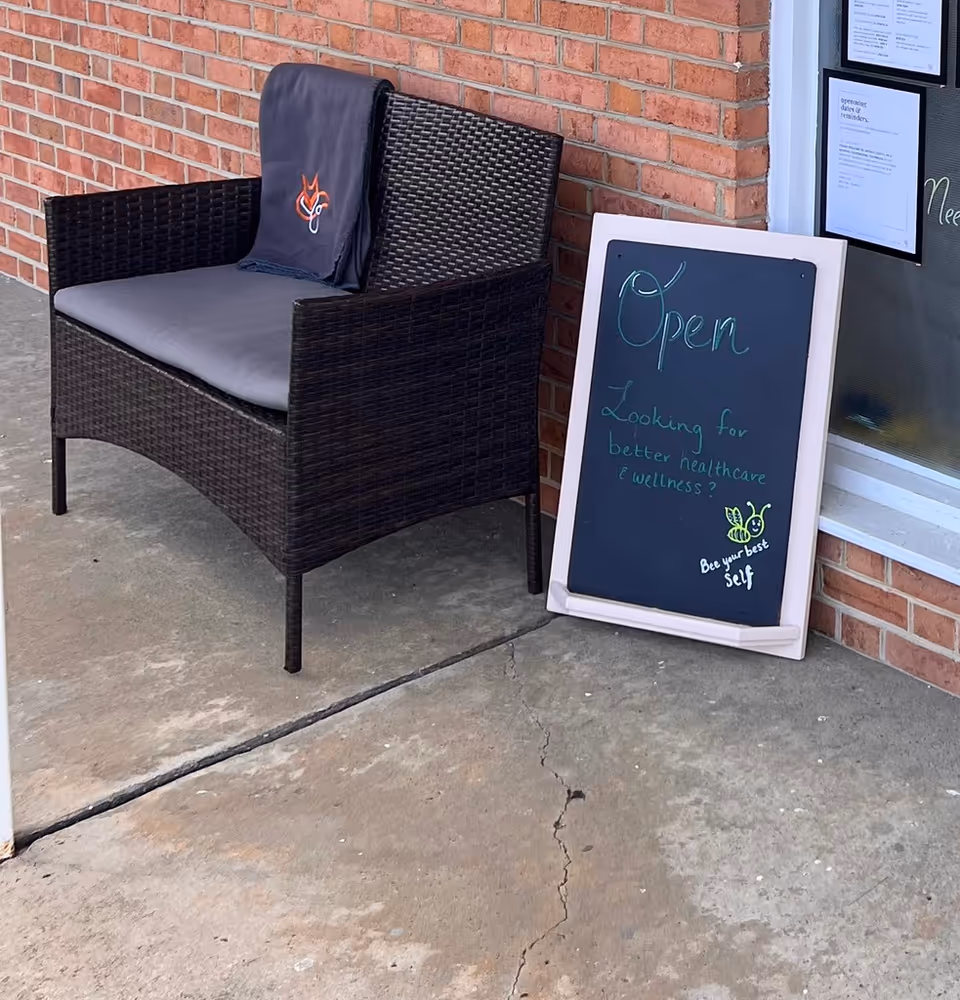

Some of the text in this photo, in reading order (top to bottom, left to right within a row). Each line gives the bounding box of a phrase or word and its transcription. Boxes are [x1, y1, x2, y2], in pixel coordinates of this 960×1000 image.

[616, 261, 750, 371] Open
[601, 380, 749, 455] Looking for
[608, 429, 767, 485] better healthcare
[700, 538, 770, 574] Bee your best
